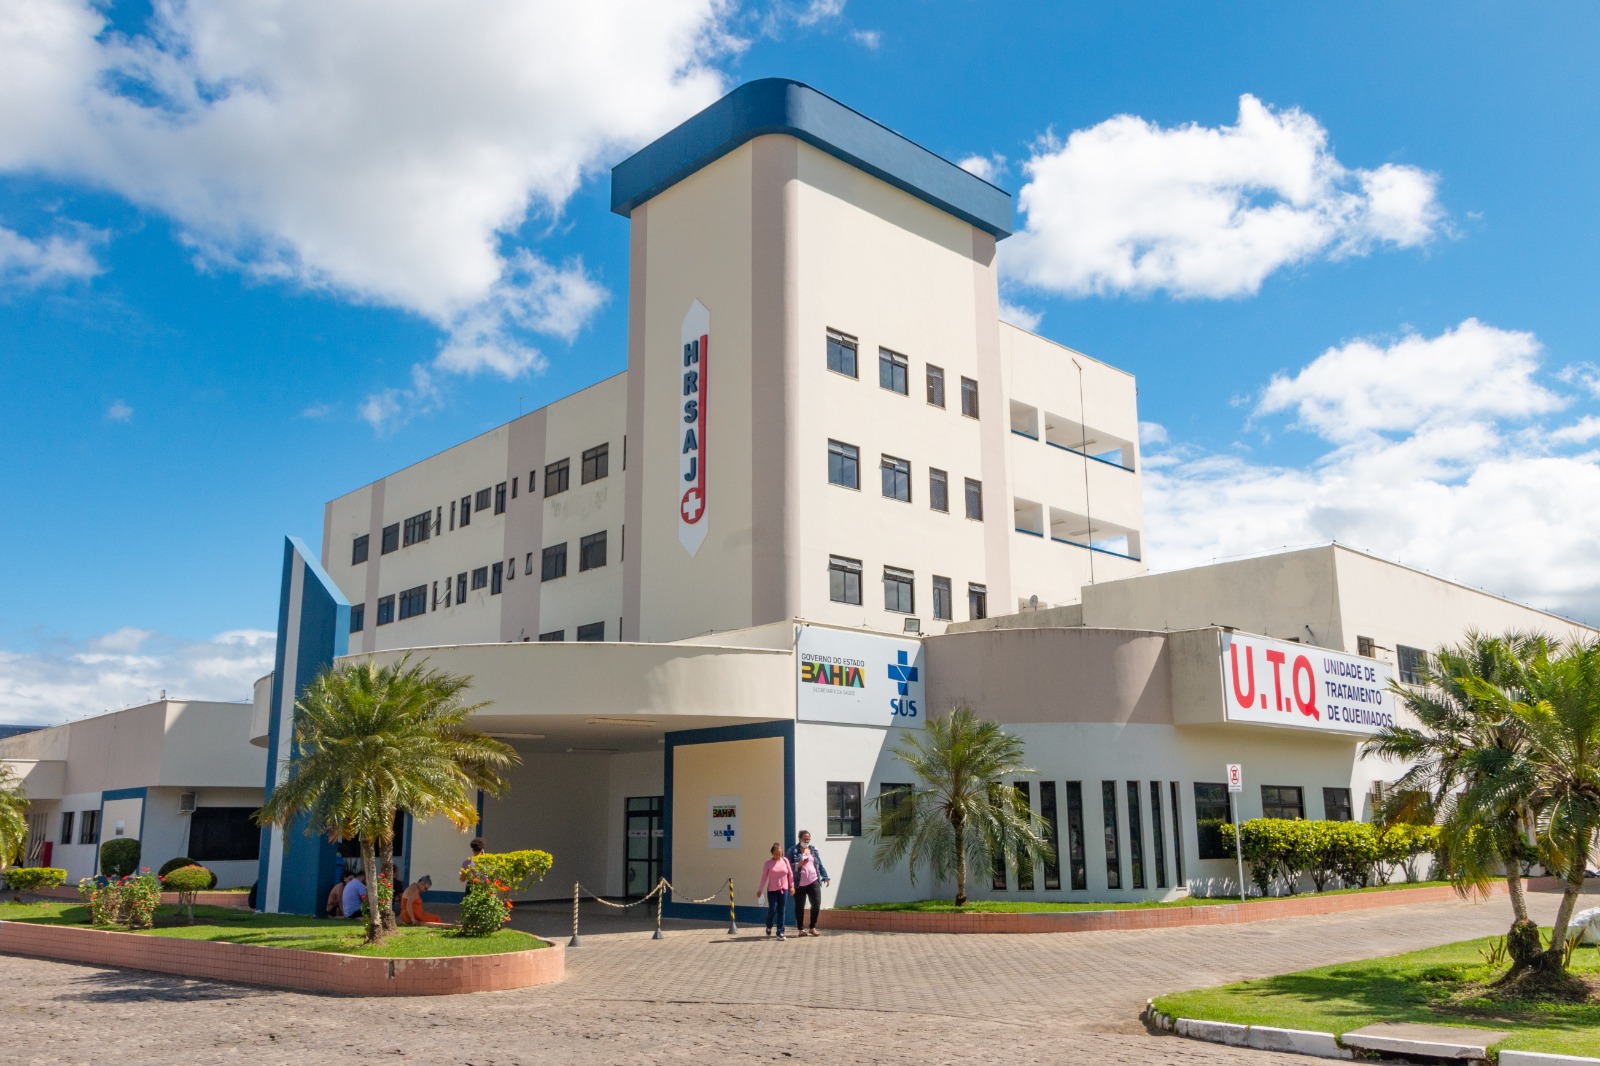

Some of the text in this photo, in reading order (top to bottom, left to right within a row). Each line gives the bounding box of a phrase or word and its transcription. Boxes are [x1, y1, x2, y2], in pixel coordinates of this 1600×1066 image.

[683, 340, 699, 482] HRSAJ
[801, 653, 865, 667] GOVERNO DO ESTADO
[1323, 657, 1376, 683] UNIDADE DE
[801, 660, 865, 689] BAHIA
[1230, 643, 1320, 722] U.T.Q
[1325, 680, 1382, 706] TRATAMENTO
[889, 698, 918, 718] SUS
[1327, 704, 1393, 728] DE QUEIMADOS
